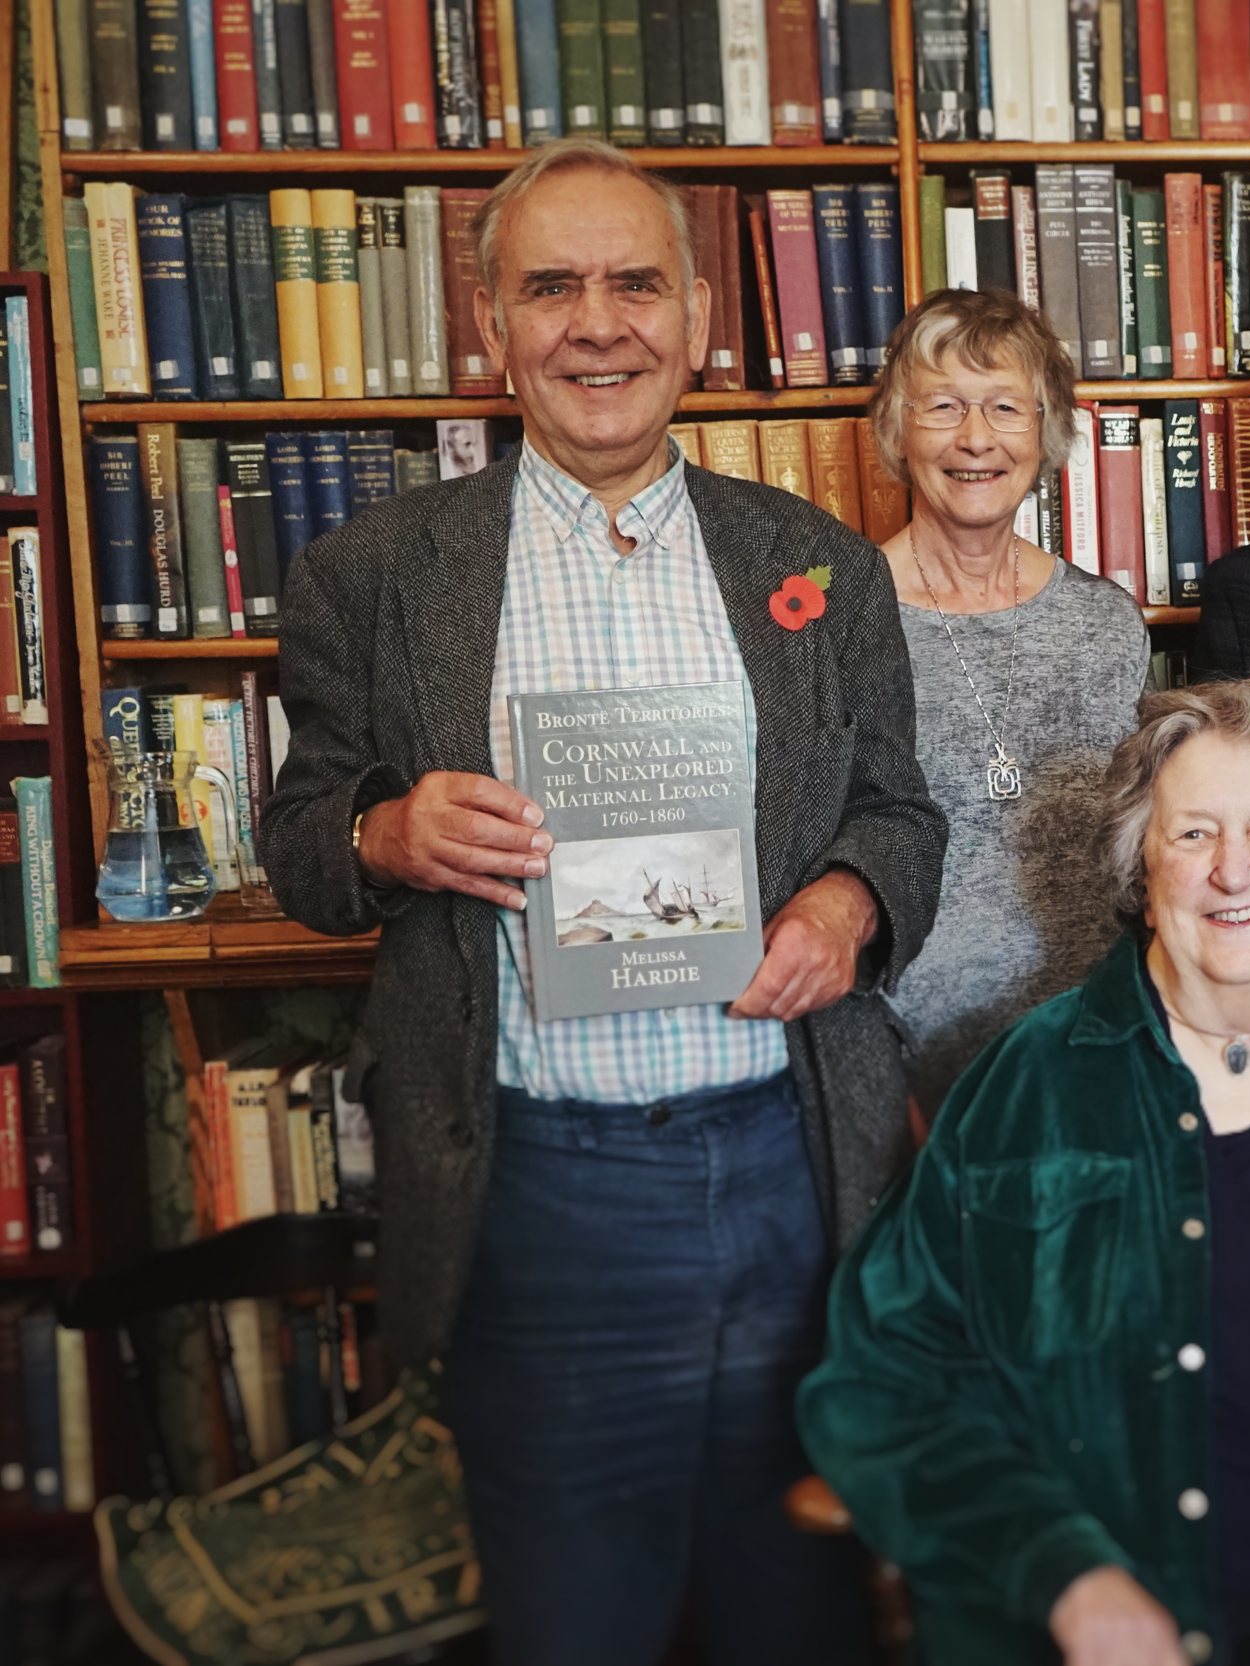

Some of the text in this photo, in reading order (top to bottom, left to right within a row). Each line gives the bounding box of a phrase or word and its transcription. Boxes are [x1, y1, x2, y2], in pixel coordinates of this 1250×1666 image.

[1076, 62, 1094, 102] LADY
[138, 216, 182, 226] BOOK OF
[145, 205, 169, 213] OUR
[139, 229, 183, 237] MEMORIES
[1023, 233, 1037, 288] RULING
[97, 238, 115, 321] JEHANNE WAKE
[109, 217, 135, 340] PRINCESS LOUISE
[1171, 413, 1196, 425] Louis
[1174, 425, 1193, 435] and
[717, 437, 745, 446] QUEEN
[1168, 435, 1199, 447] Victoria
[100, 461, 132, 470] ROBERT
[104, 472, 130, 480] PEEL
[1173, 468, 1199, 478] Richard
[1175, 478, 1196, 488] Hough
[147, 434, 171, 607] Robert Peel DOUGLAS HURD
[1041, 510, 1051, 537] STELLA
[1074, 472, 1086, 550] JESSICA MITFORD
[537, 703, 735, 730] BRONTË TERRITORIES:
[242, 680, 260, 797] QUEEN VICTORIA'S CHILDREN
[542, 737, 733, 765] CORNWALL AND
[233, 711, 251, 831] QUEEN VICTORIA WAS AMUSED
[543, 758, 734, 787] THE UNEXPLORED
[545, 782, 738, 810] MATERNAL LEGACY,
[25, 805, 45, 959] KING WITHOUT A CROWN
[40, 839, 55, 925] Daphne Bennett
[621, 951, 687, 967] MELISSA
[611, 966, 700, 989] HARDIE
